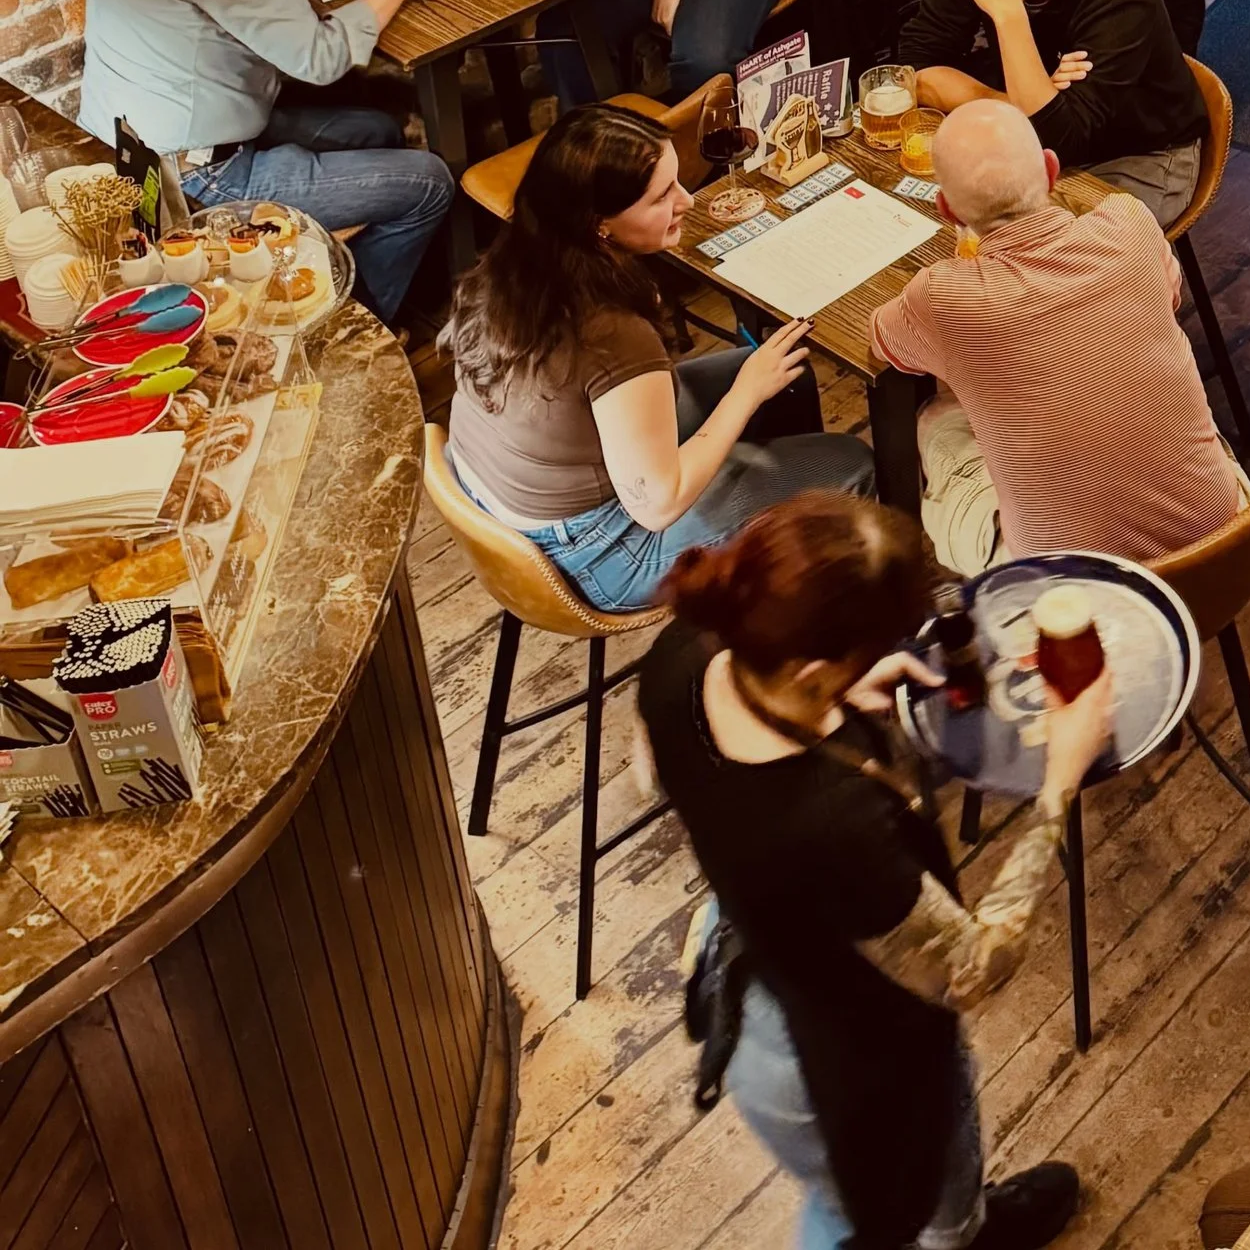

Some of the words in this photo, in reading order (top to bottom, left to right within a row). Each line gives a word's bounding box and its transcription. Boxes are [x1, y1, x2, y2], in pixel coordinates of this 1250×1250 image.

[820, 68, 833, 100] Raffle
[86, 705, 116, 715] PRO
[90, 722, 157, 741] STRAWS
[2, 774, 60, 786] COCKTAIL
[3, 782, 50, 793] STRAWS
